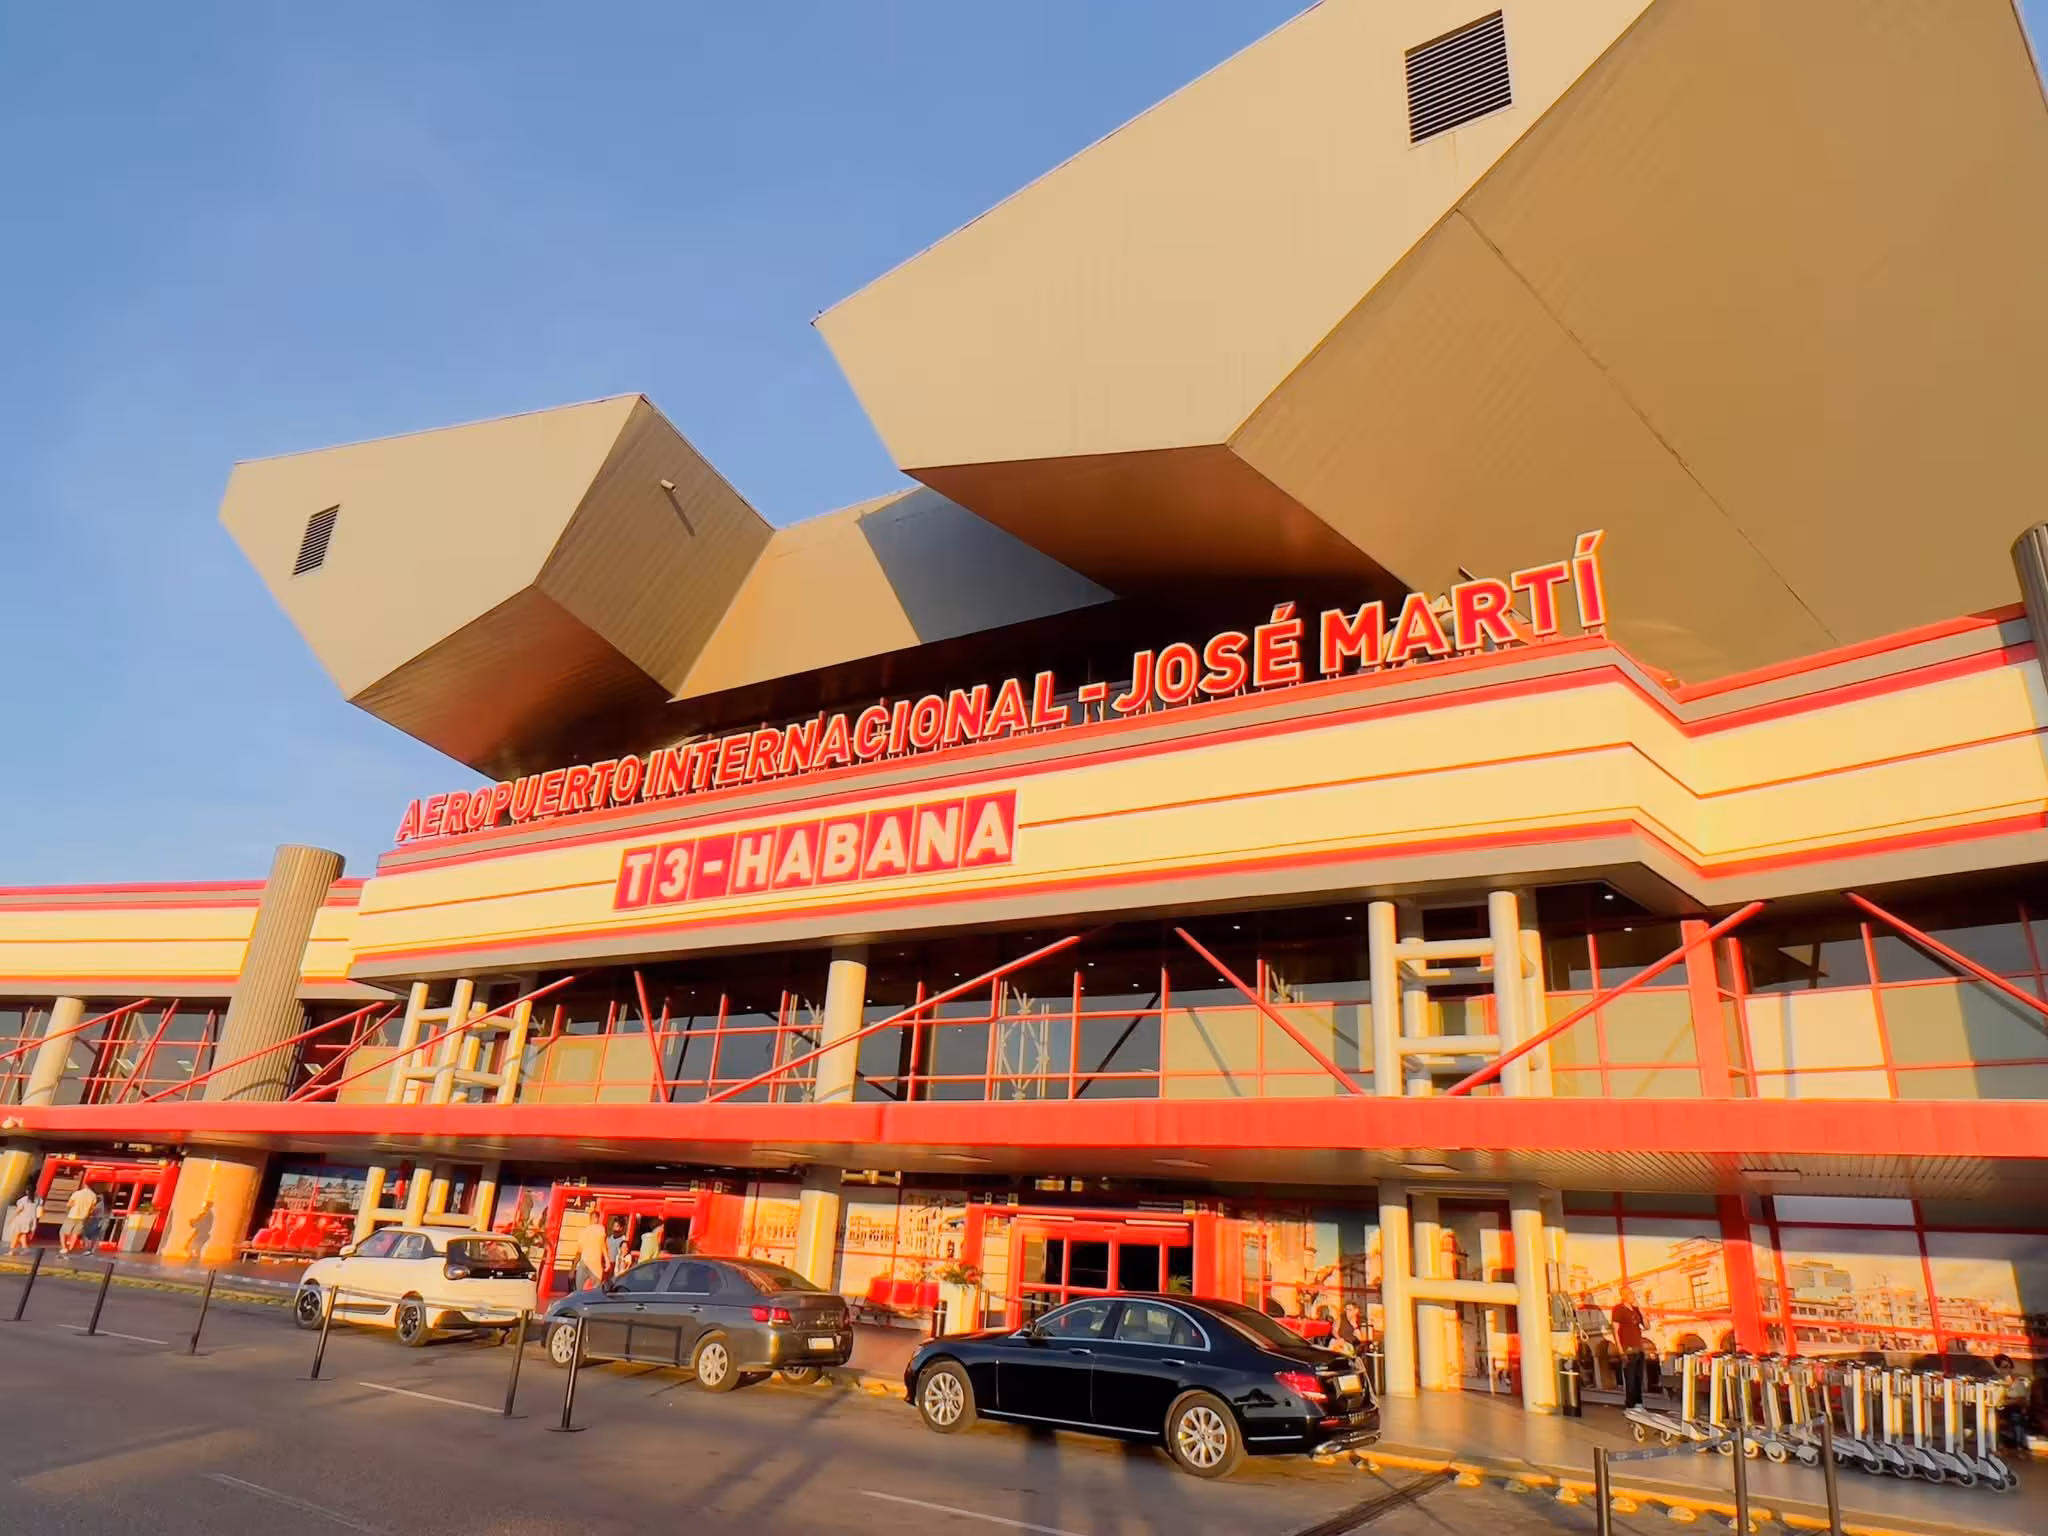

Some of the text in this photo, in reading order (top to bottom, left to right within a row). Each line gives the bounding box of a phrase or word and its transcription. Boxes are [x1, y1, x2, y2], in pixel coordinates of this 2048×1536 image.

[396, 529, 1605, 842] AEROPUERTO INTERNACIONAL - JOSÉ MARTÍ
